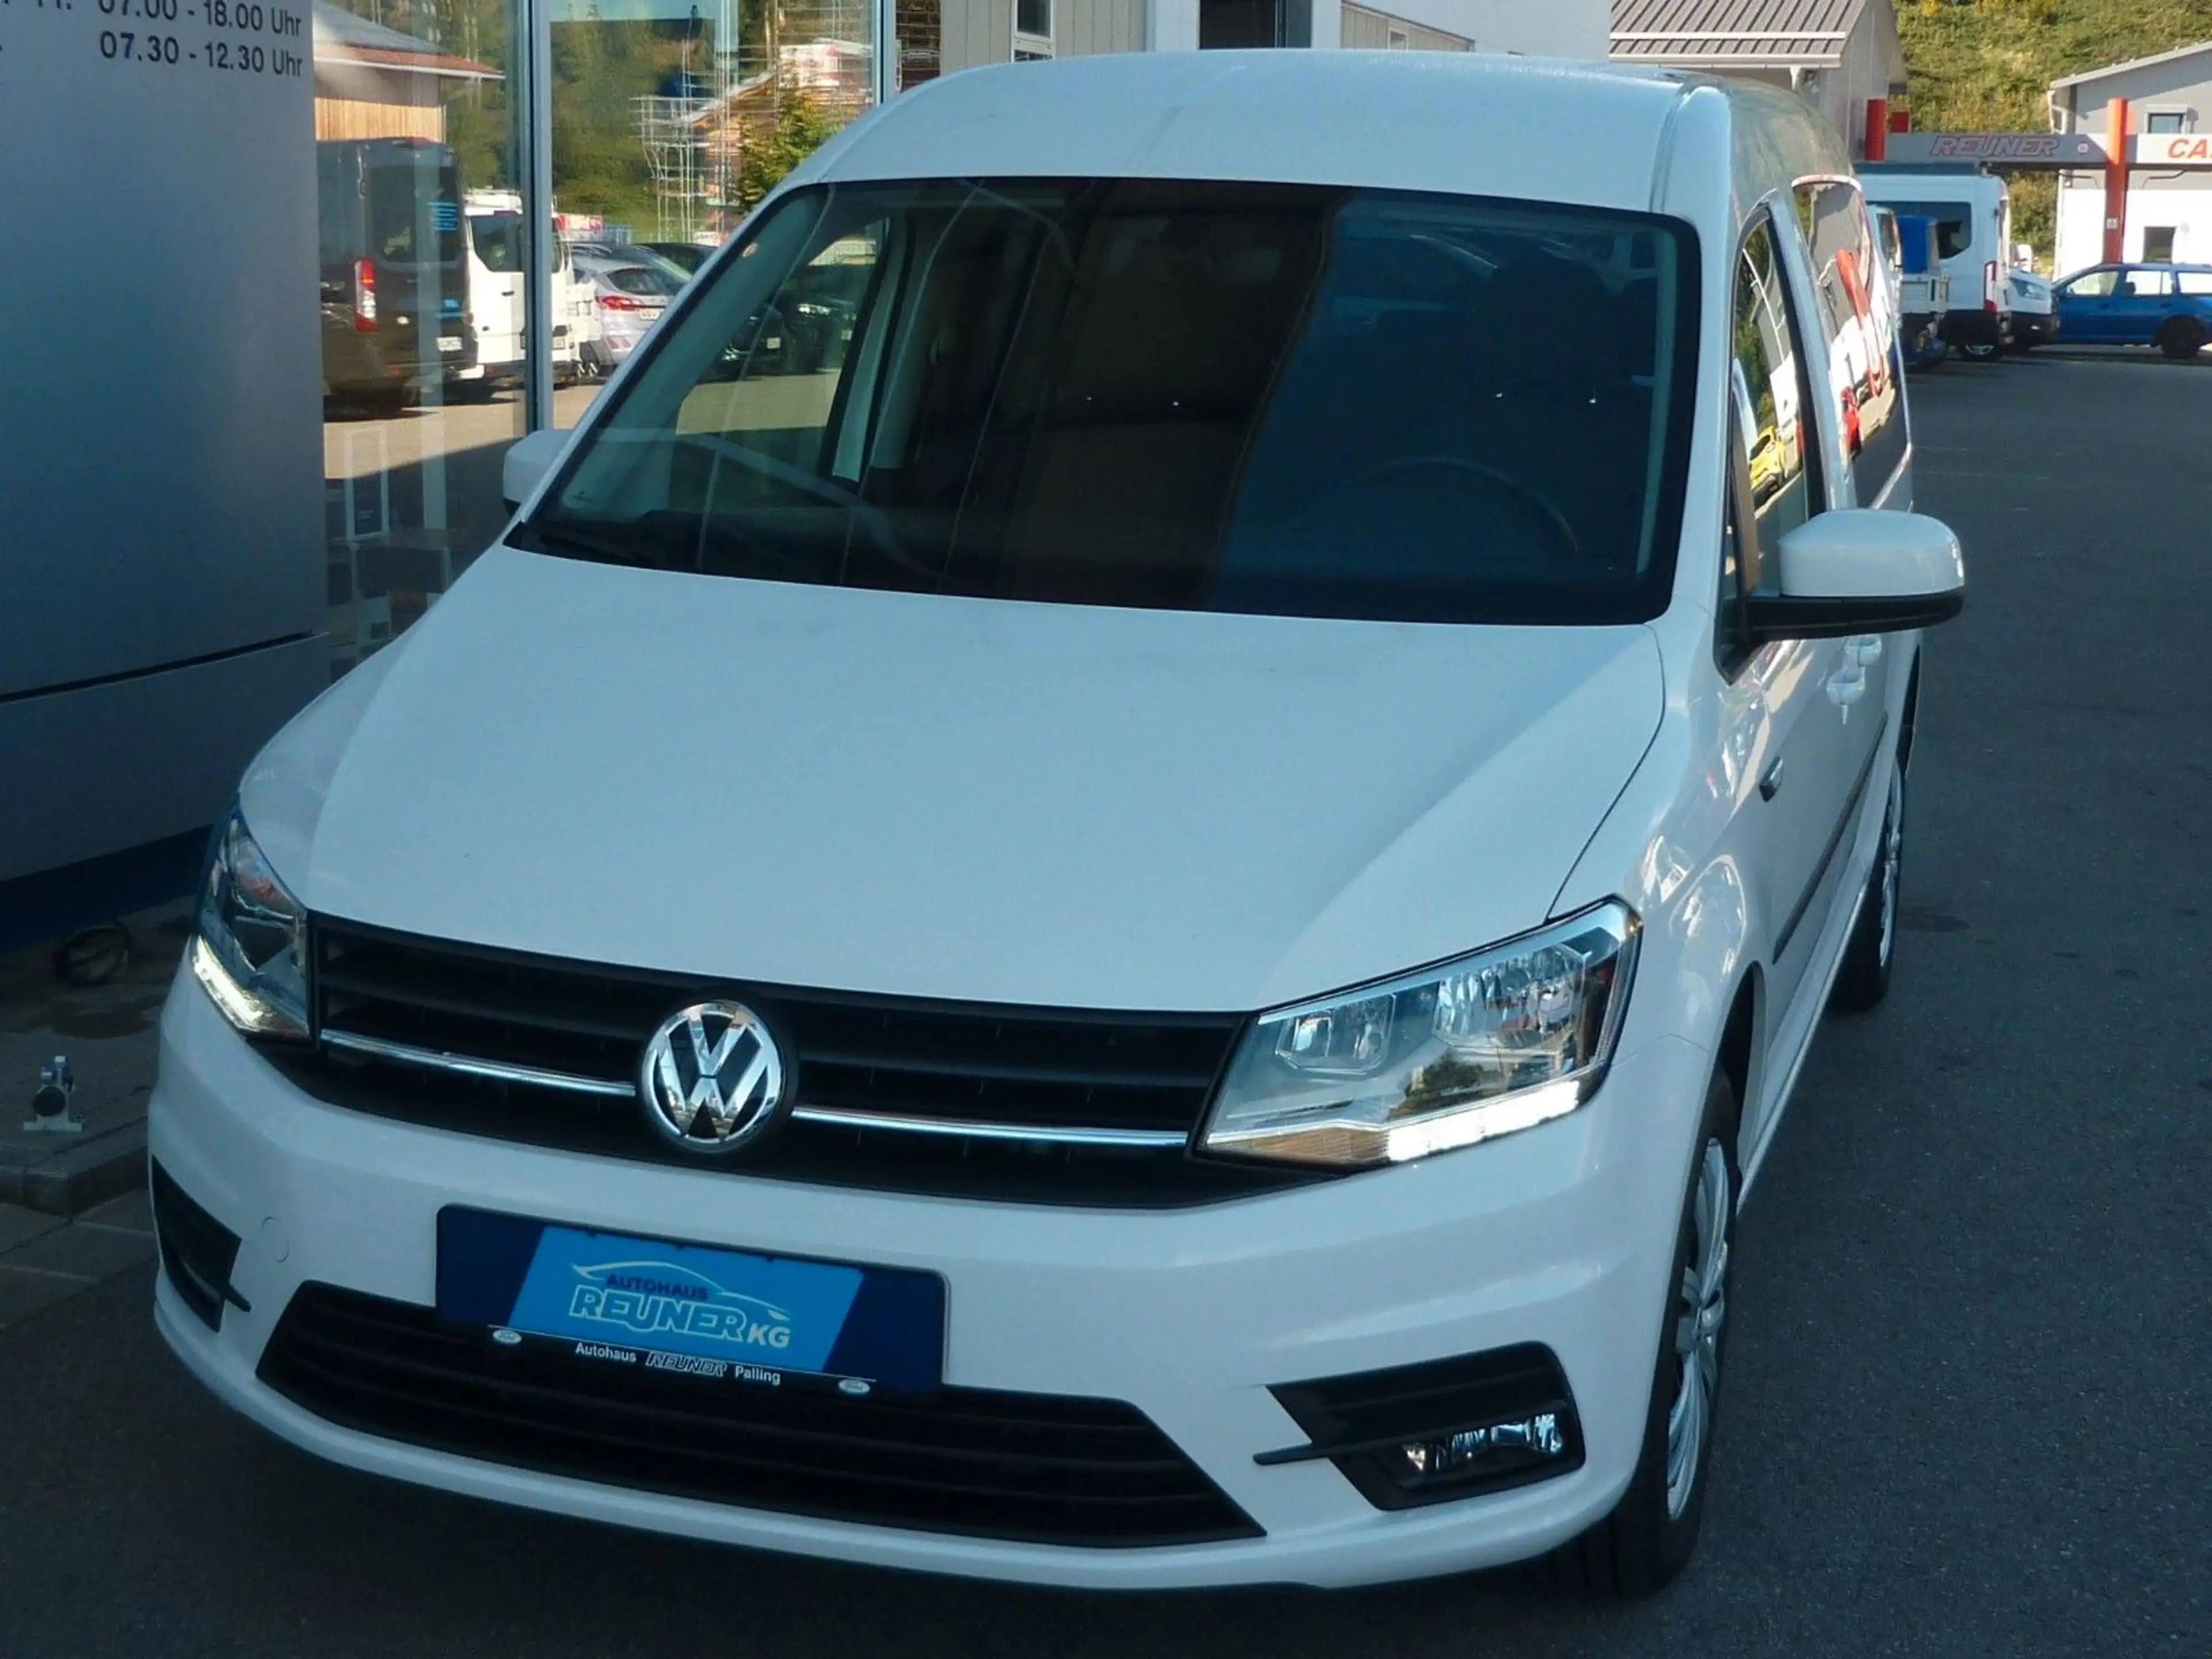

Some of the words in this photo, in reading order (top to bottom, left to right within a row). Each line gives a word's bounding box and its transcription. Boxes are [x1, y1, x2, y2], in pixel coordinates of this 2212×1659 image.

[203, 0, 263, 31] 18.00
[271, 6, 302, 37] Uhr
[100, 31, 180, 64] 07.30
[204, 41, 264, 73] 12.30
[272, 48, 303, 77] Uhr
[1930, 134, 2060, 157] REUNER
[2168, 138, 2212, 158] CA
[605, 1274, 709, 1301] AUTOHAUS
[569, 1284, 748, 1343] REUNER
[747, 1322, 791, 1349] KG
[575, 1341, 637, 1363] Autohaus
[645, 1349, 729, 1377] REUNER
[734, 1365, 782, 1387] Palling
